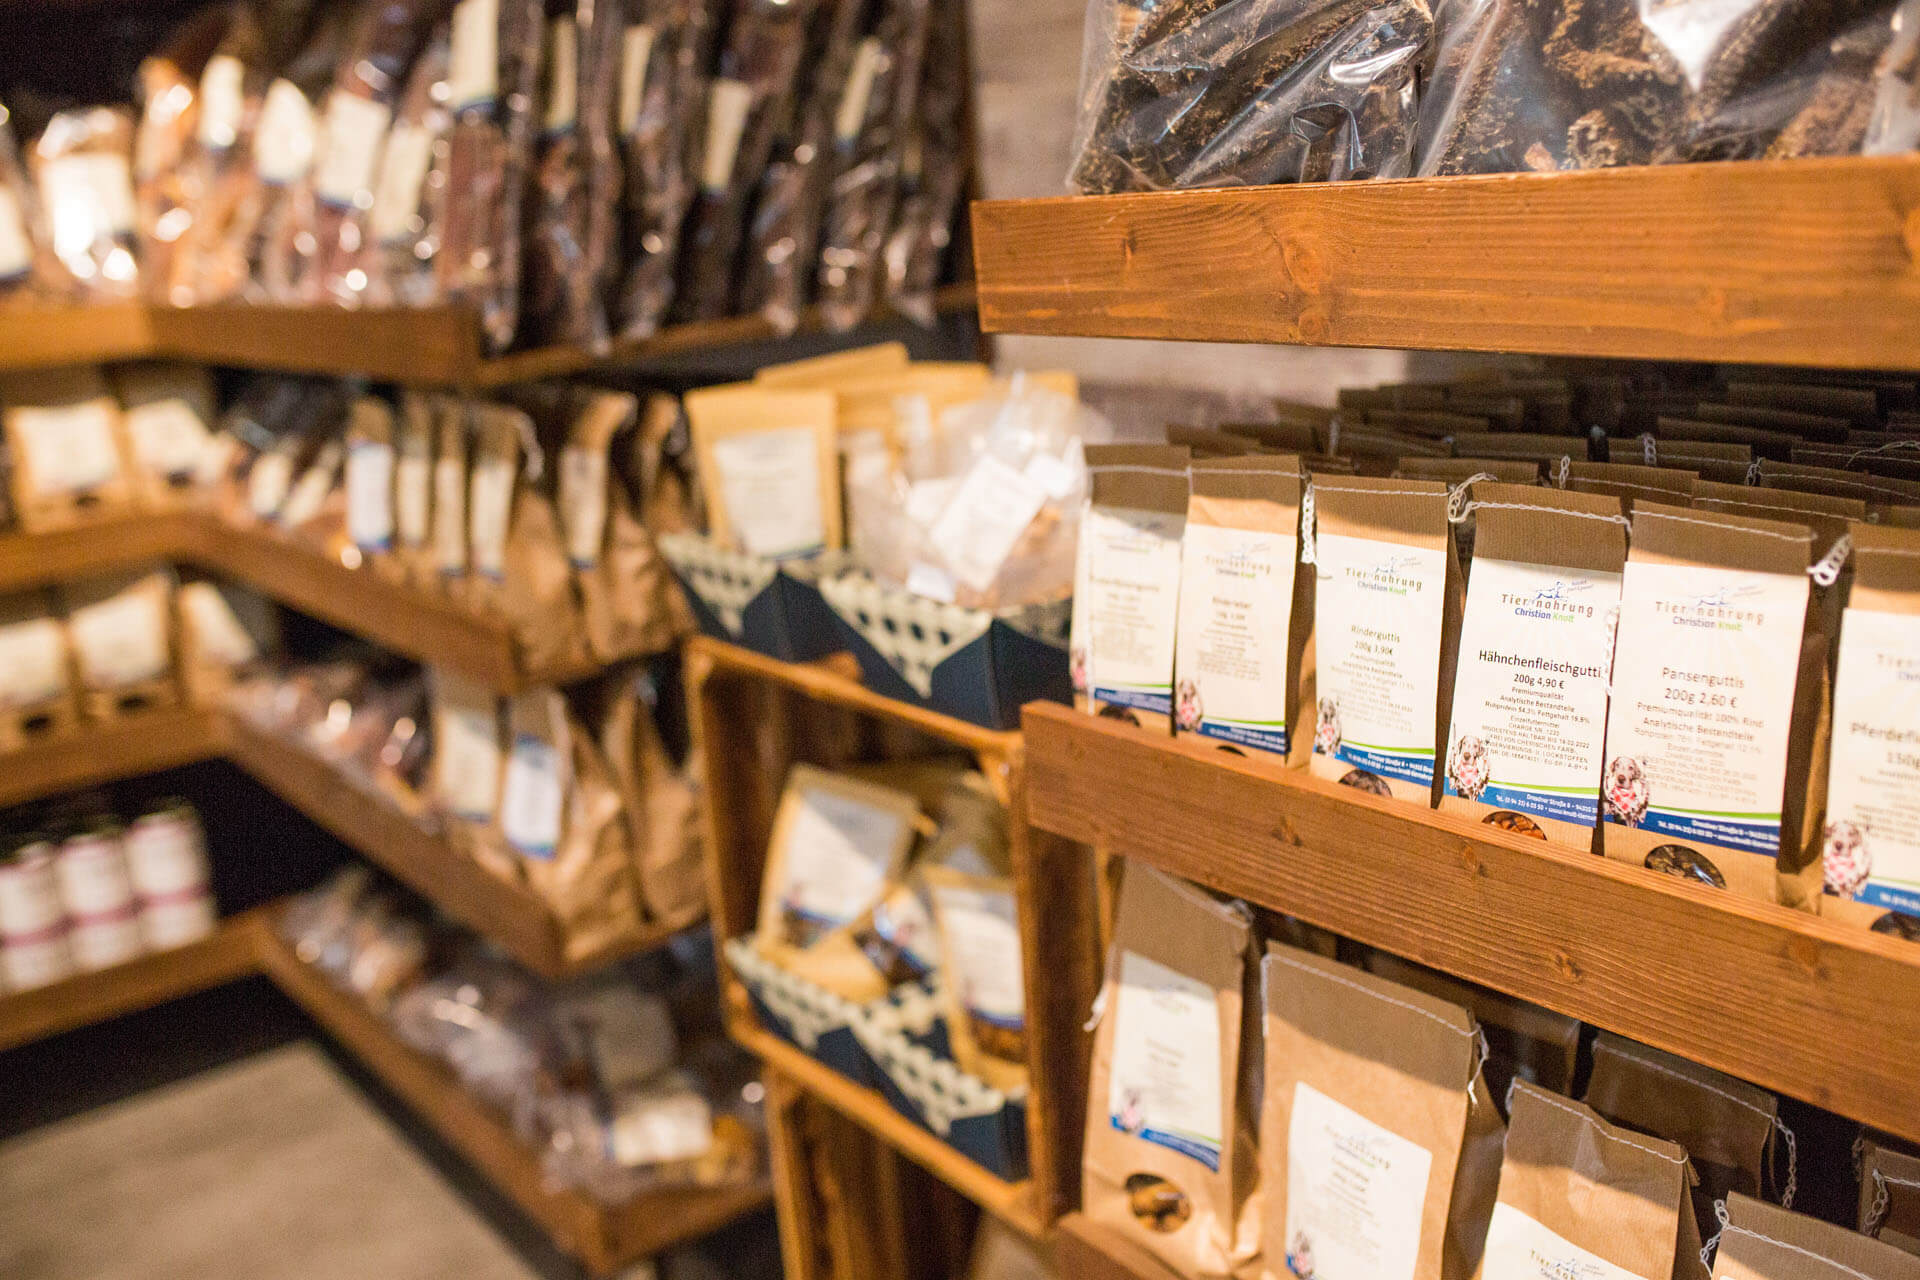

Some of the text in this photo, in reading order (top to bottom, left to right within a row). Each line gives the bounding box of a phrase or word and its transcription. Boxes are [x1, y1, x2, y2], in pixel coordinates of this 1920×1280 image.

[1514, 607, 1551, 620] Christian
[1673, 616, 1715, 629] Christian
[1351, 624, 1400, 643] Rinderguttis
[1479, 650, 1603, 678] Hähnchenfleischgutti
[1513, 673, 1565, 689] 200g 4,90 €
[1662, 667, 1744, 689] Pansenguttis
[1511, 687, 1564, 701] Premiumqualität
[1664, 688, 1738, 708] 200g 2,60 €
[1500, 695, 1576, 713] Analytische Bestandteile
